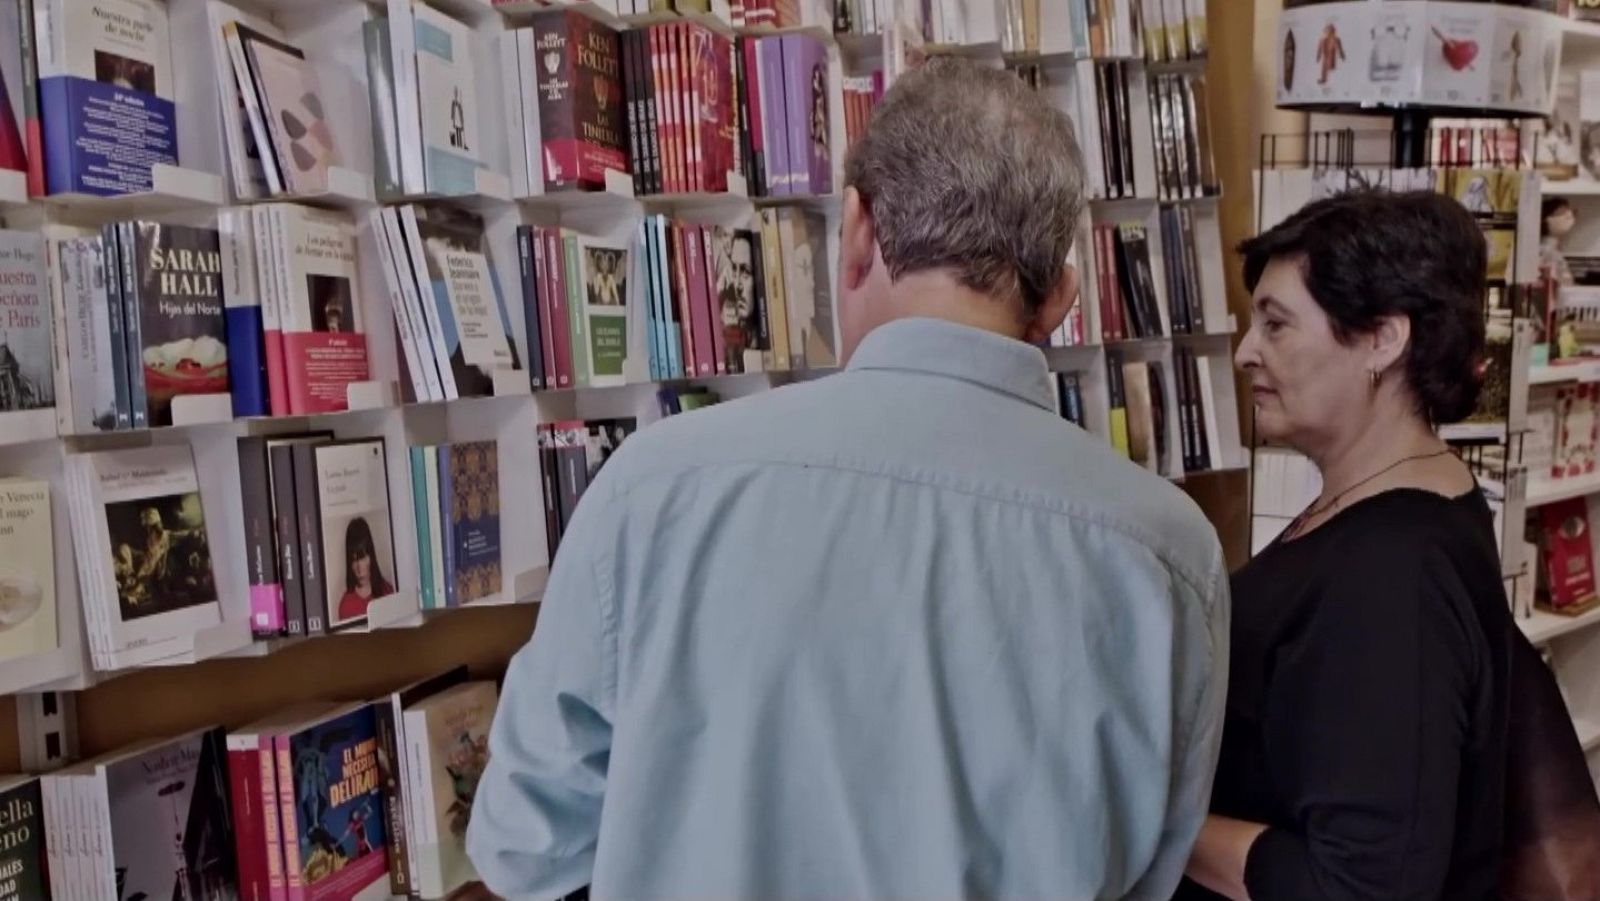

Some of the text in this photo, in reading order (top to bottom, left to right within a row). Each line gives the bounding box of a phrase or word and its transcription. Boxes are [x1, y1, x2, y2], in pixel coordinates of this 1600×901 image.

[104, 22, 119, 33] de
[588, 32, 610, 54] KEN
[150, 248, 221, 273] SARAH
[160, 271, 218, 297] HALL
[183, 301, 197, 316] del
[0, 825, 30, 851] no
[0, 859, 24, 880] ALES
